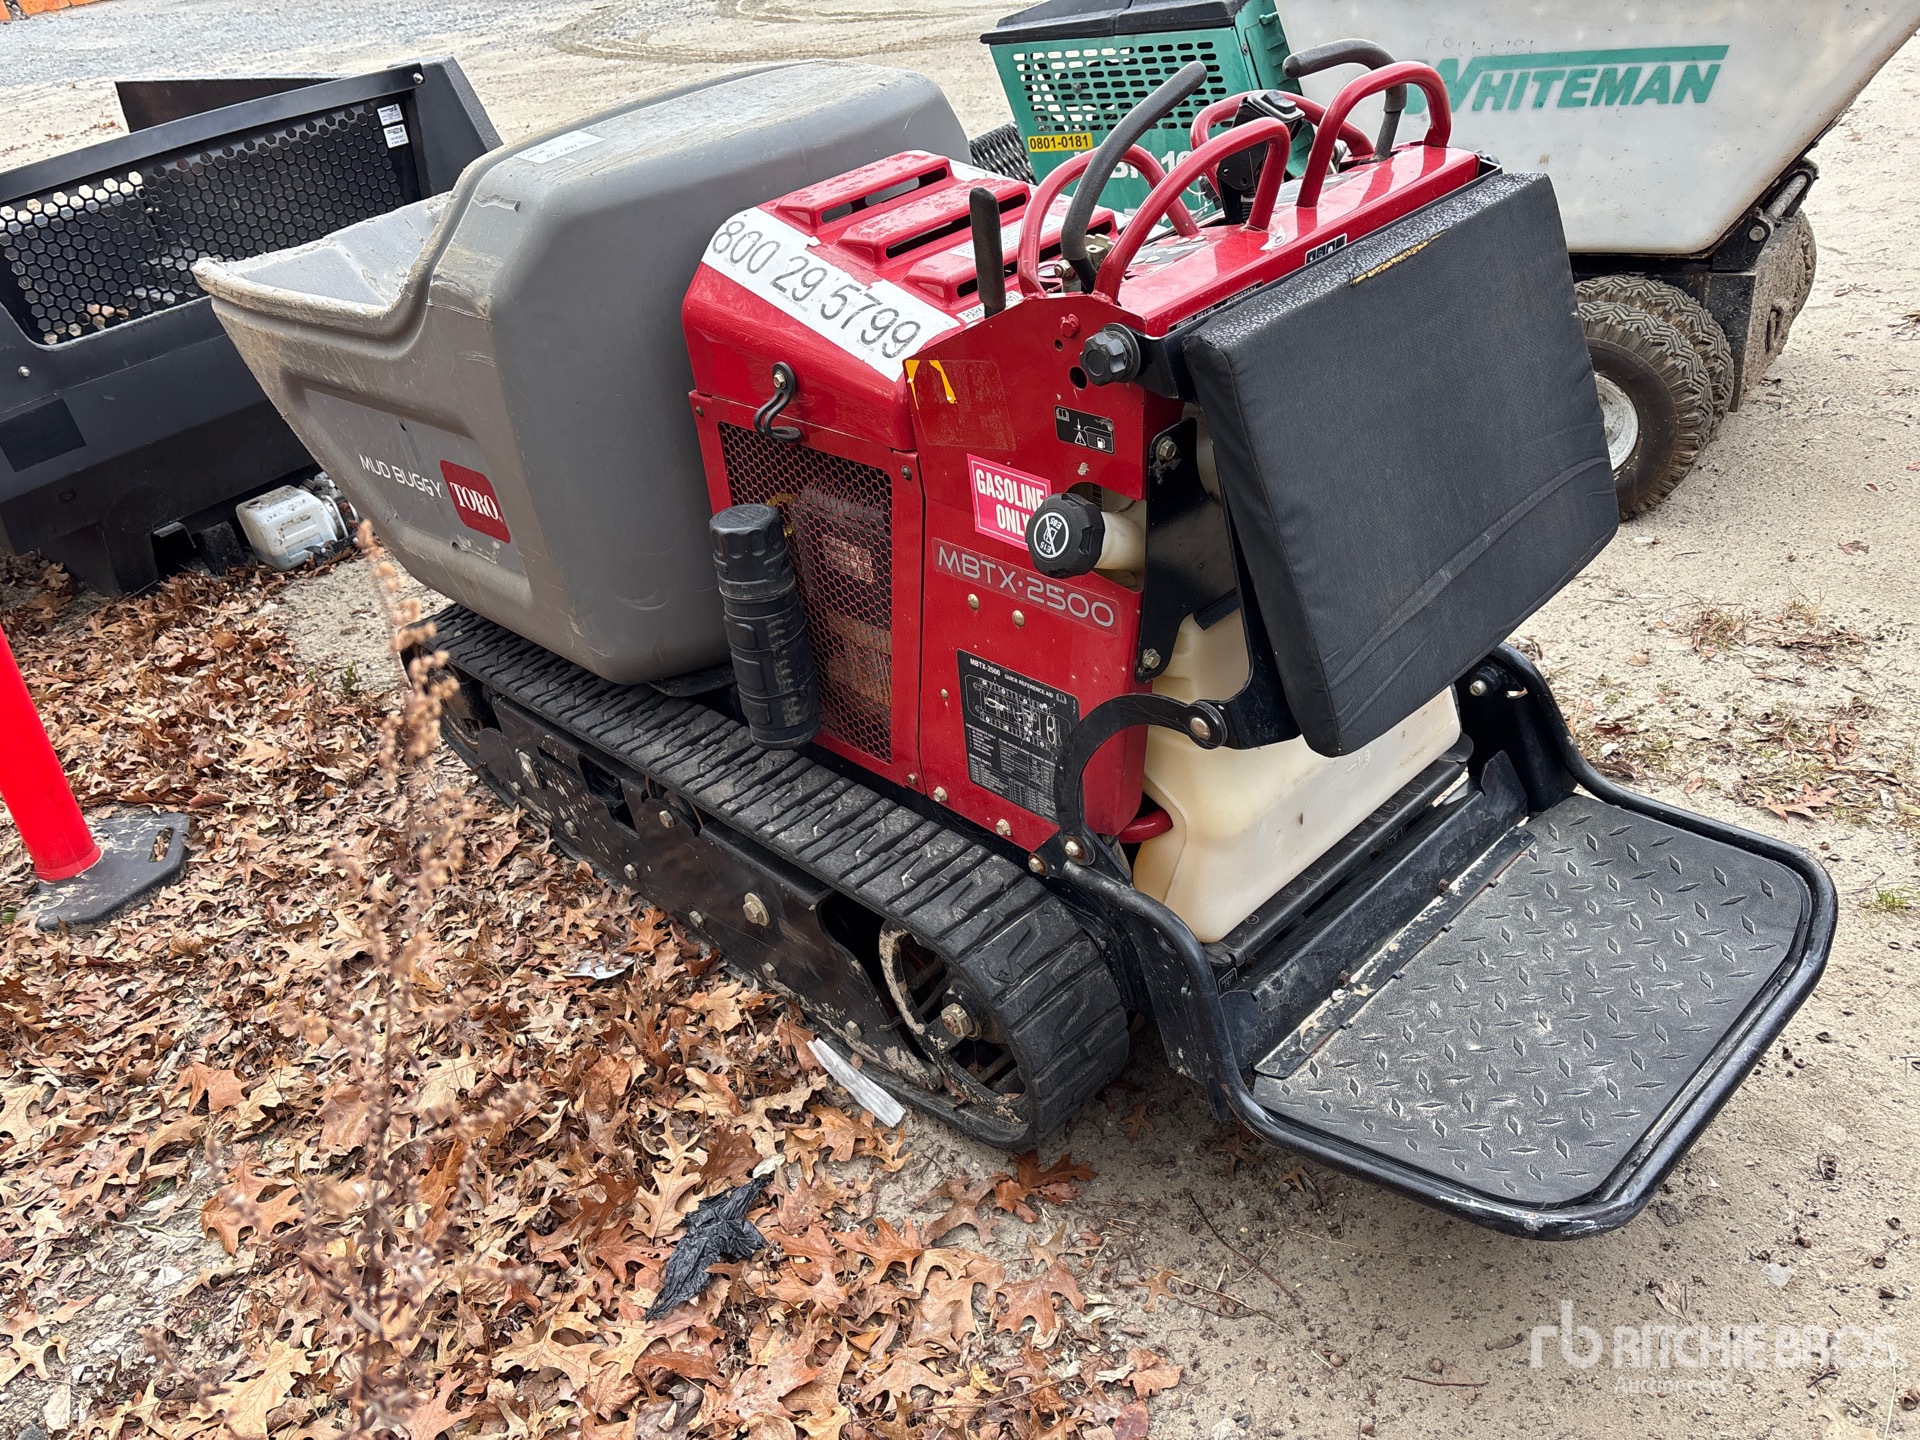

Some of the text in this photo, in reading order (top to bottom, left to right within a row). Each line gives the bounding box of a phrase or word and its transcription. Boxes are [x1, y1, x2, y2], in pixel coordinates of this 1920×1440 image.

[1029, 135, 1089, 150] 0801-0181
[819, 283, 922, 359] 5799
[359, 454, 443, 498] MUD BUGGY
[975, 468, 1045, 512] GASOLINE
[450, 482, 500, 520] TORO
[996, 504, 1030, 536] ONLY
[1040, 541, 1052, 554] E15
[970, 658, 1000, 677] MBTX-2500
